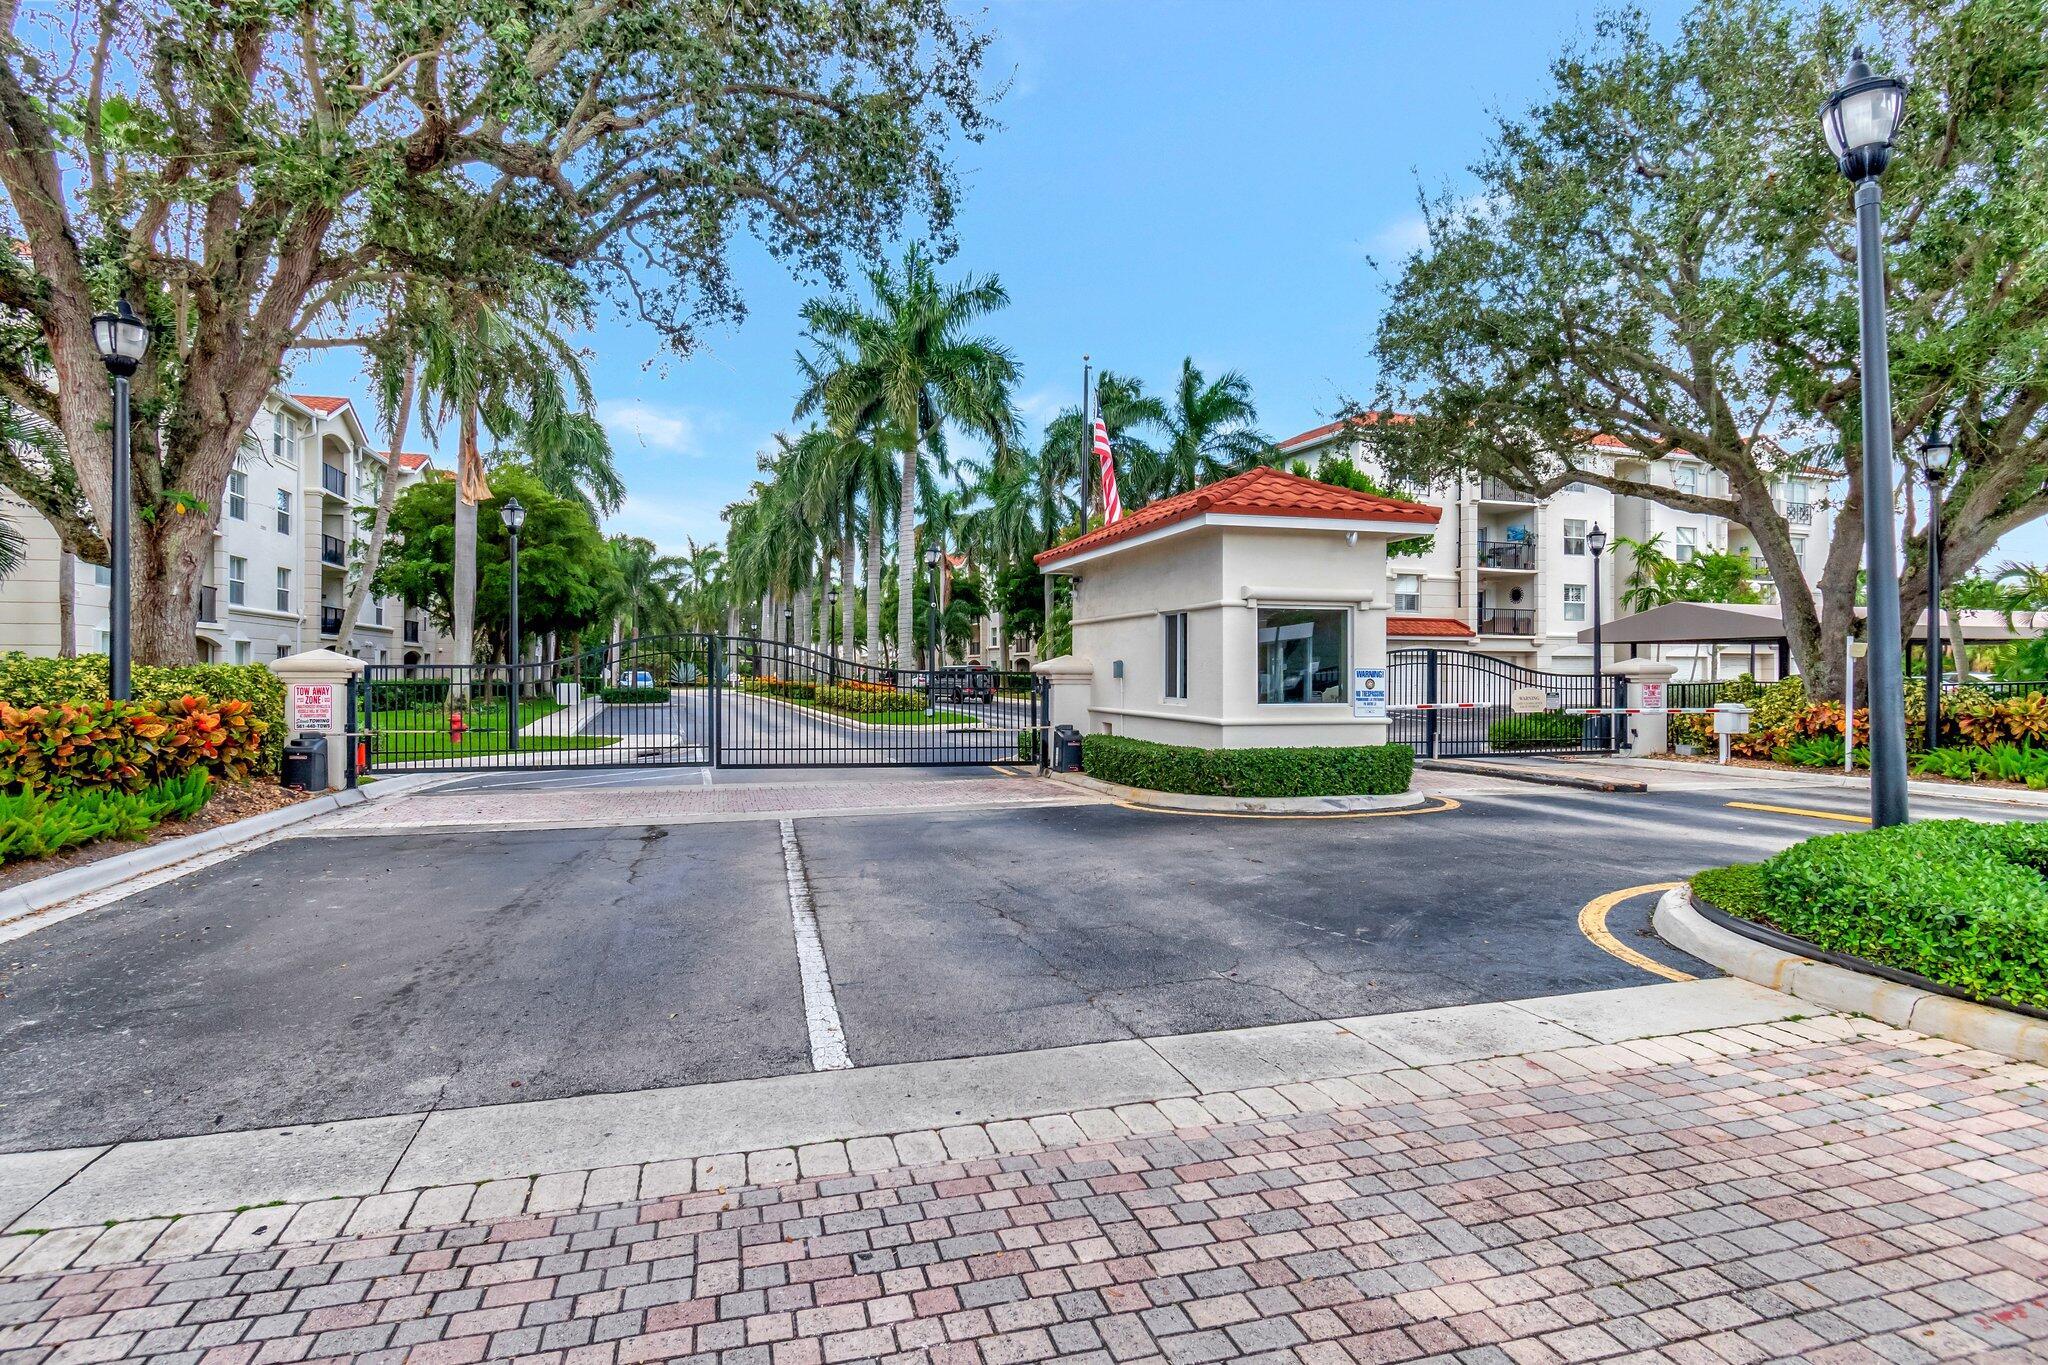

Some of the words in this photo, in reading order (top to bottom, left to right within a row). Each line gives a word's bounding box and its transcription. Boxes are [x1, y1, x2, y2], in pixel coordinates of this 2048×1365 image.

[296, 687, 310, 696] TOW
[312, 687, 330, 696] AWAY
[305, 696, 321, 704] ZONE
